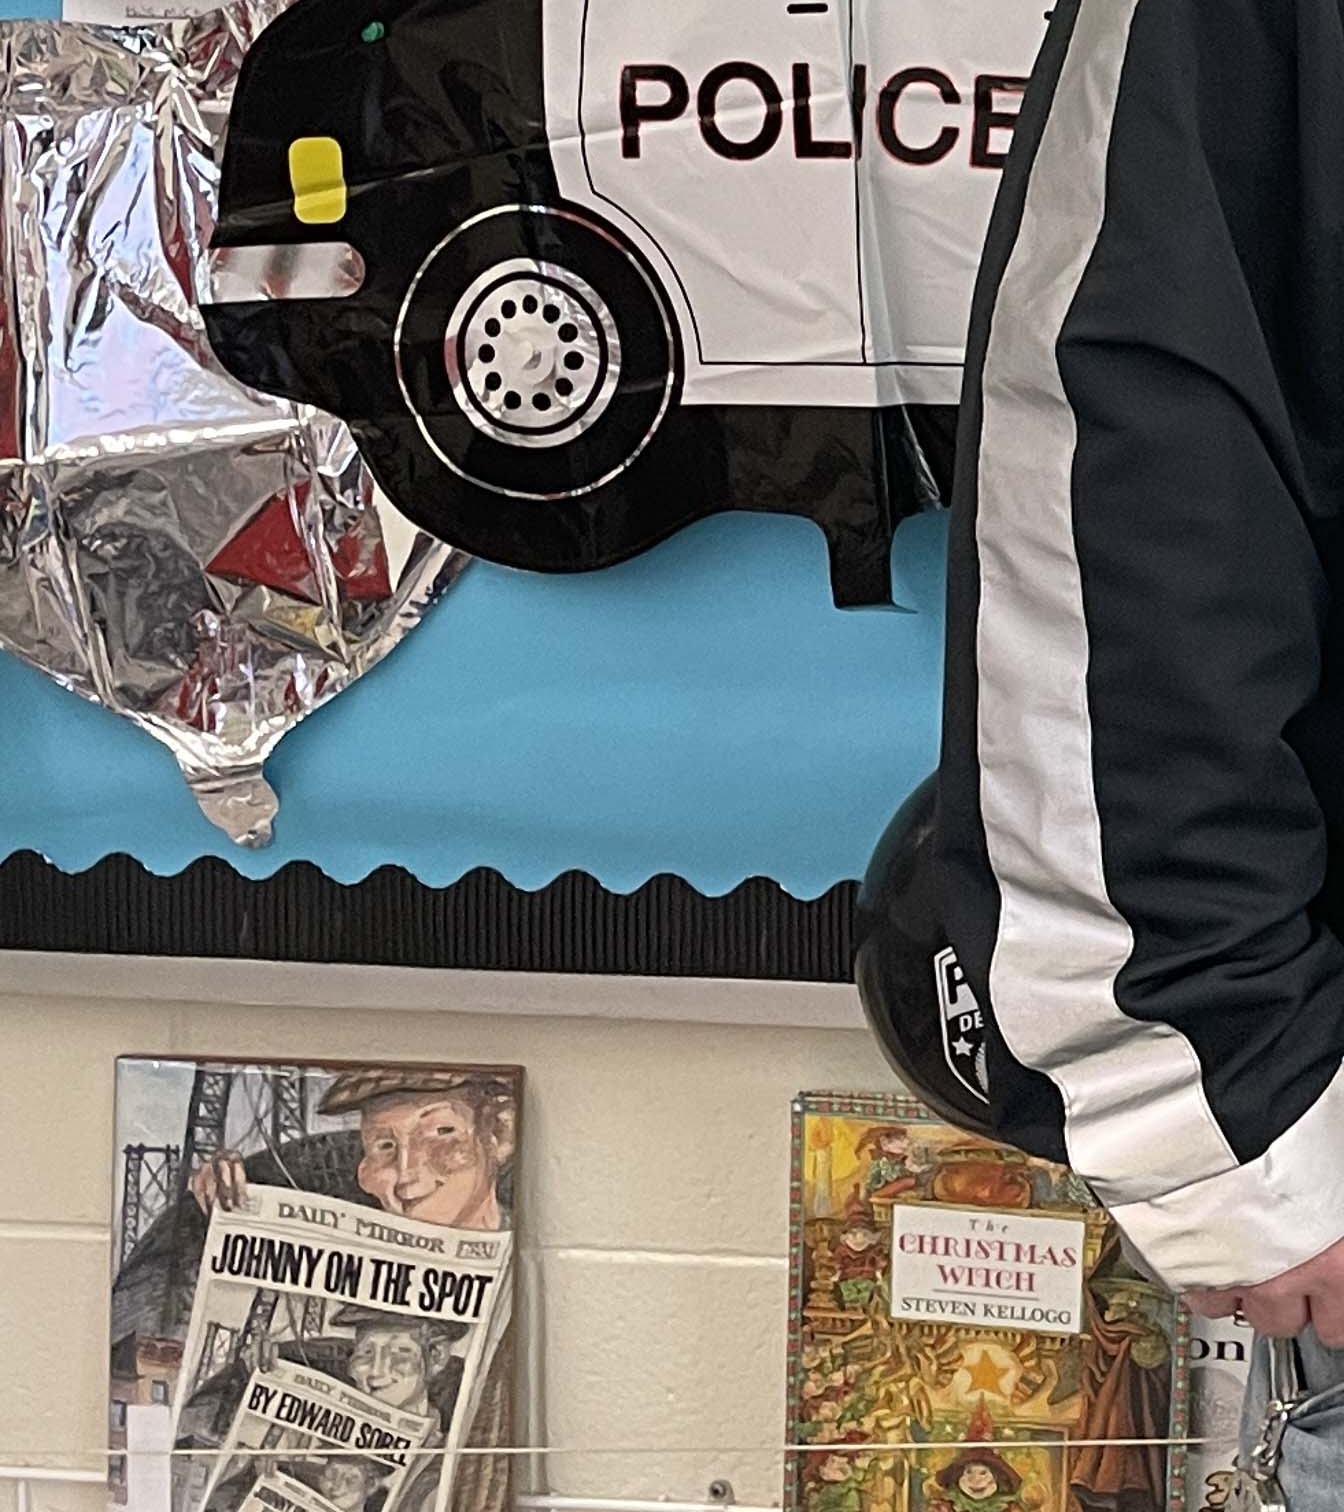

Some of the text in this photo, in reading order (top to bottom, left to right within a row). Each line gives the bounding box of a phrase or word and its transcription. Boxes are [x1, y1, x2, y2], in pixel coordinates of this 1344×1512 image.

[620, 61, 1031, 170] POLICE
[354, 1215, 447, 1254] MIRROR
[968, 1217, 1011, 1235] The
[898, 1231, 1079, 1269] CHRISTMAS
[211, 1232, 494, 1319] JOHNNY ON THE SPOT
[936, 1262, 1037, 1294] WITCH
[901, 1296, 1073, 1326] STEVEN KELLOGG
[248, 1382, 279, 1416] BY
[275, 1391, 357, 1444] EDWARD
